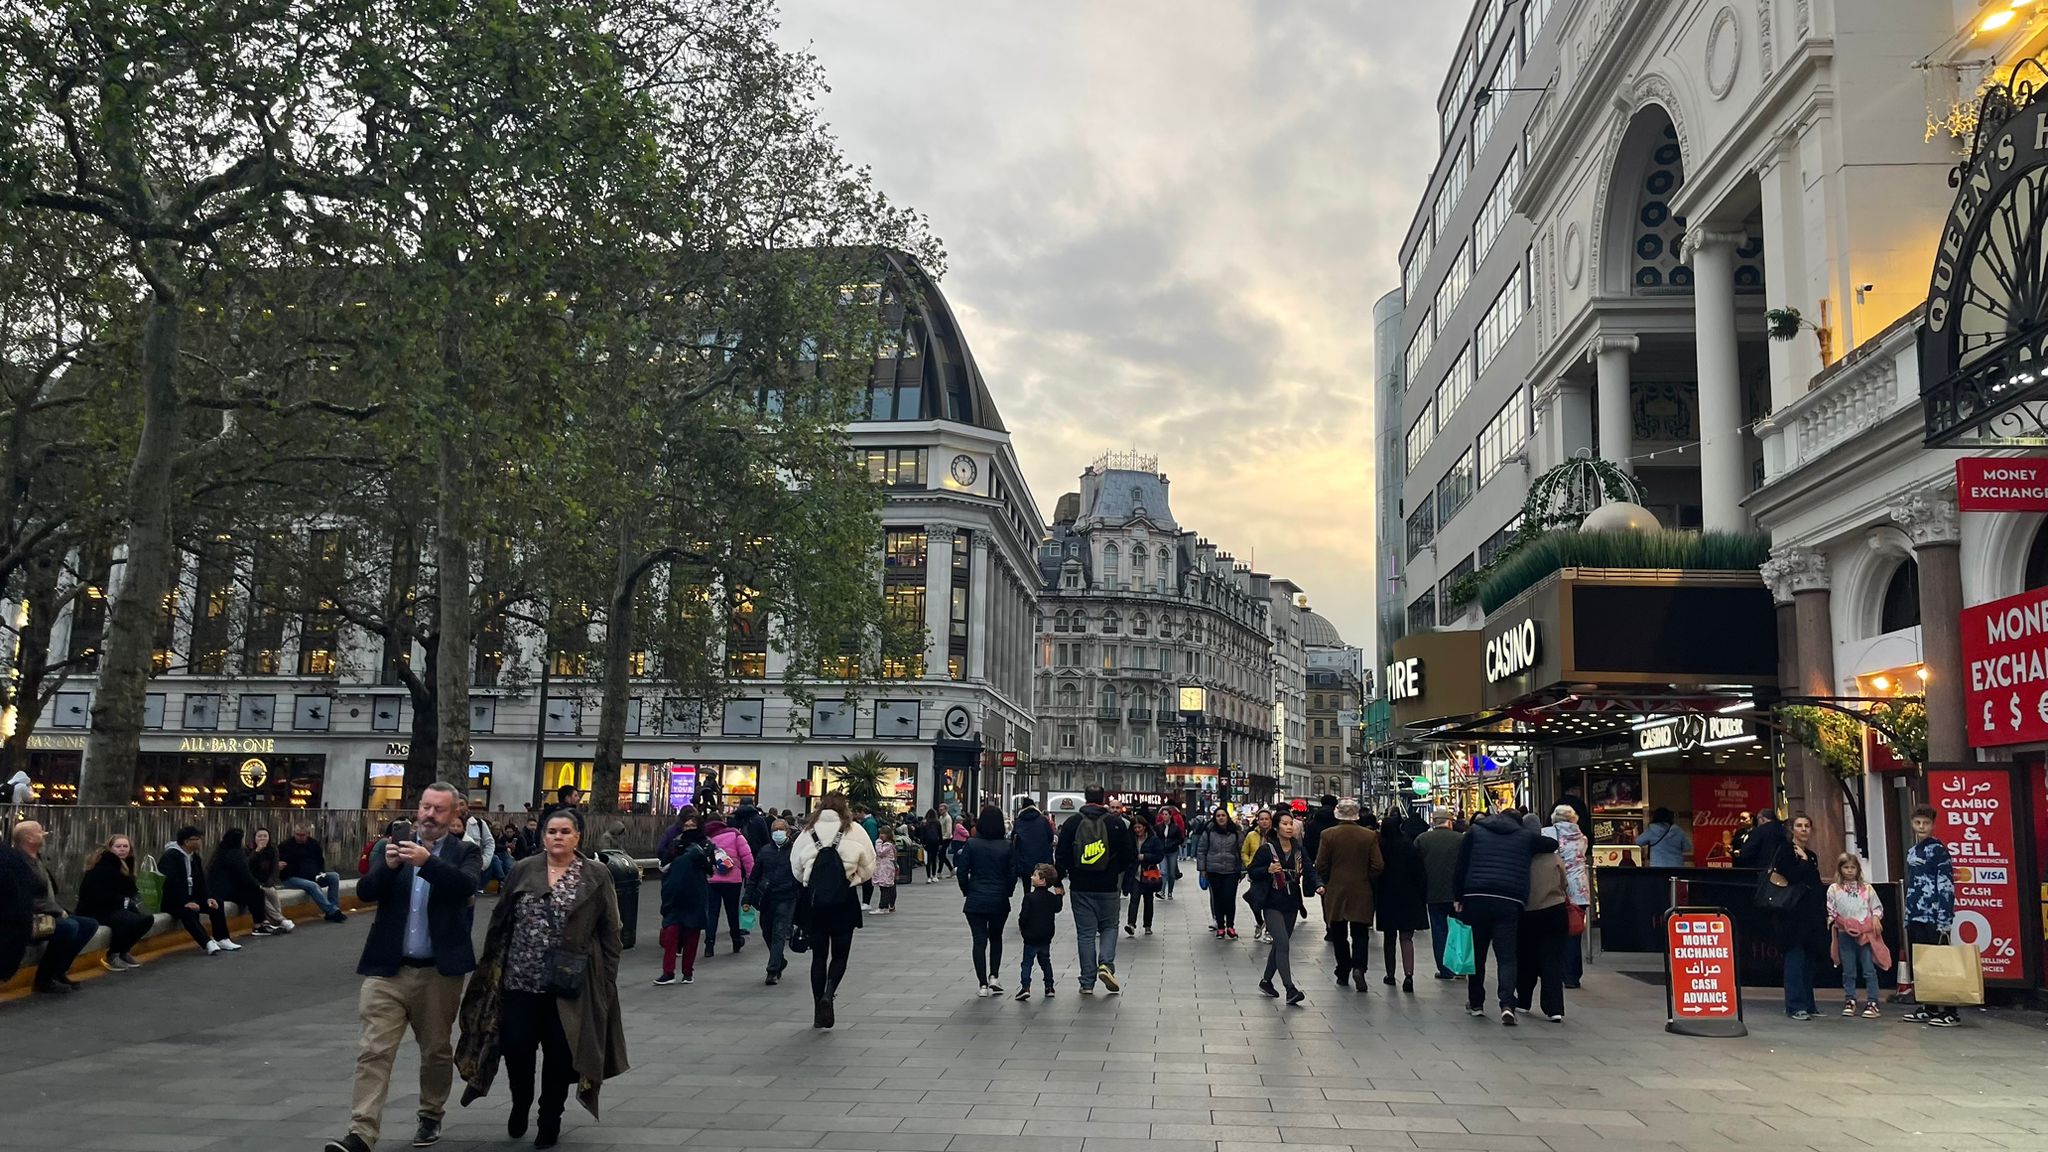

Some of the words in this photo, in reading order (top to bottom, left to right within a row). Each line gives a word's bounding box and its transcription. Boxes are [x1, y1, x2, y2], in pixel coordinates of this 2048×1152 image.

[1930, 134, 2015, 333] QUEEN'S
[1983, 469, 2037, 480] MONEY
[1486, 618, 1535, 683] CASINO
[1386, 657, 1419, 702] PIRE
[1983, 700, 1995, 731] £
[2009, 692, 2022, 731] $
[1640, 725, 1671, 750] CASINO
[1709, 717, 1743, 739] POKER
[56, 735, 86, 748] ONE
[180, 737, 206, 752] ALL
[210, 738, 238, 752] BAR
[243, 738, 275, 753] ONE
[1942, 776, 1991, 796] صراف
[1117, 793, 1133, 804] PRET
[1941, 798, 1999, 809] CAMBIO
[1948, 812, 1994, 826] BUY
[1964, 827, 1981, 841] &
[1084, 840, 1104, 858] NIKE
[1947, 842, 2001, 857] SELL
[1980, 871, 2005, 880] VISA
[1962, 887, 1991, 896] CASH
[1954, 898, 2003, 907] ADVANCE
[1683, 935, 1718, 946] MONEY
[1675, 948, 1729, 959] EXCHANGE
[1685, 960, 1721, 977] صراف
[1691, 979, 1718, 990] CASH
[1684, 992, 1727, 1003] ADVANCE
